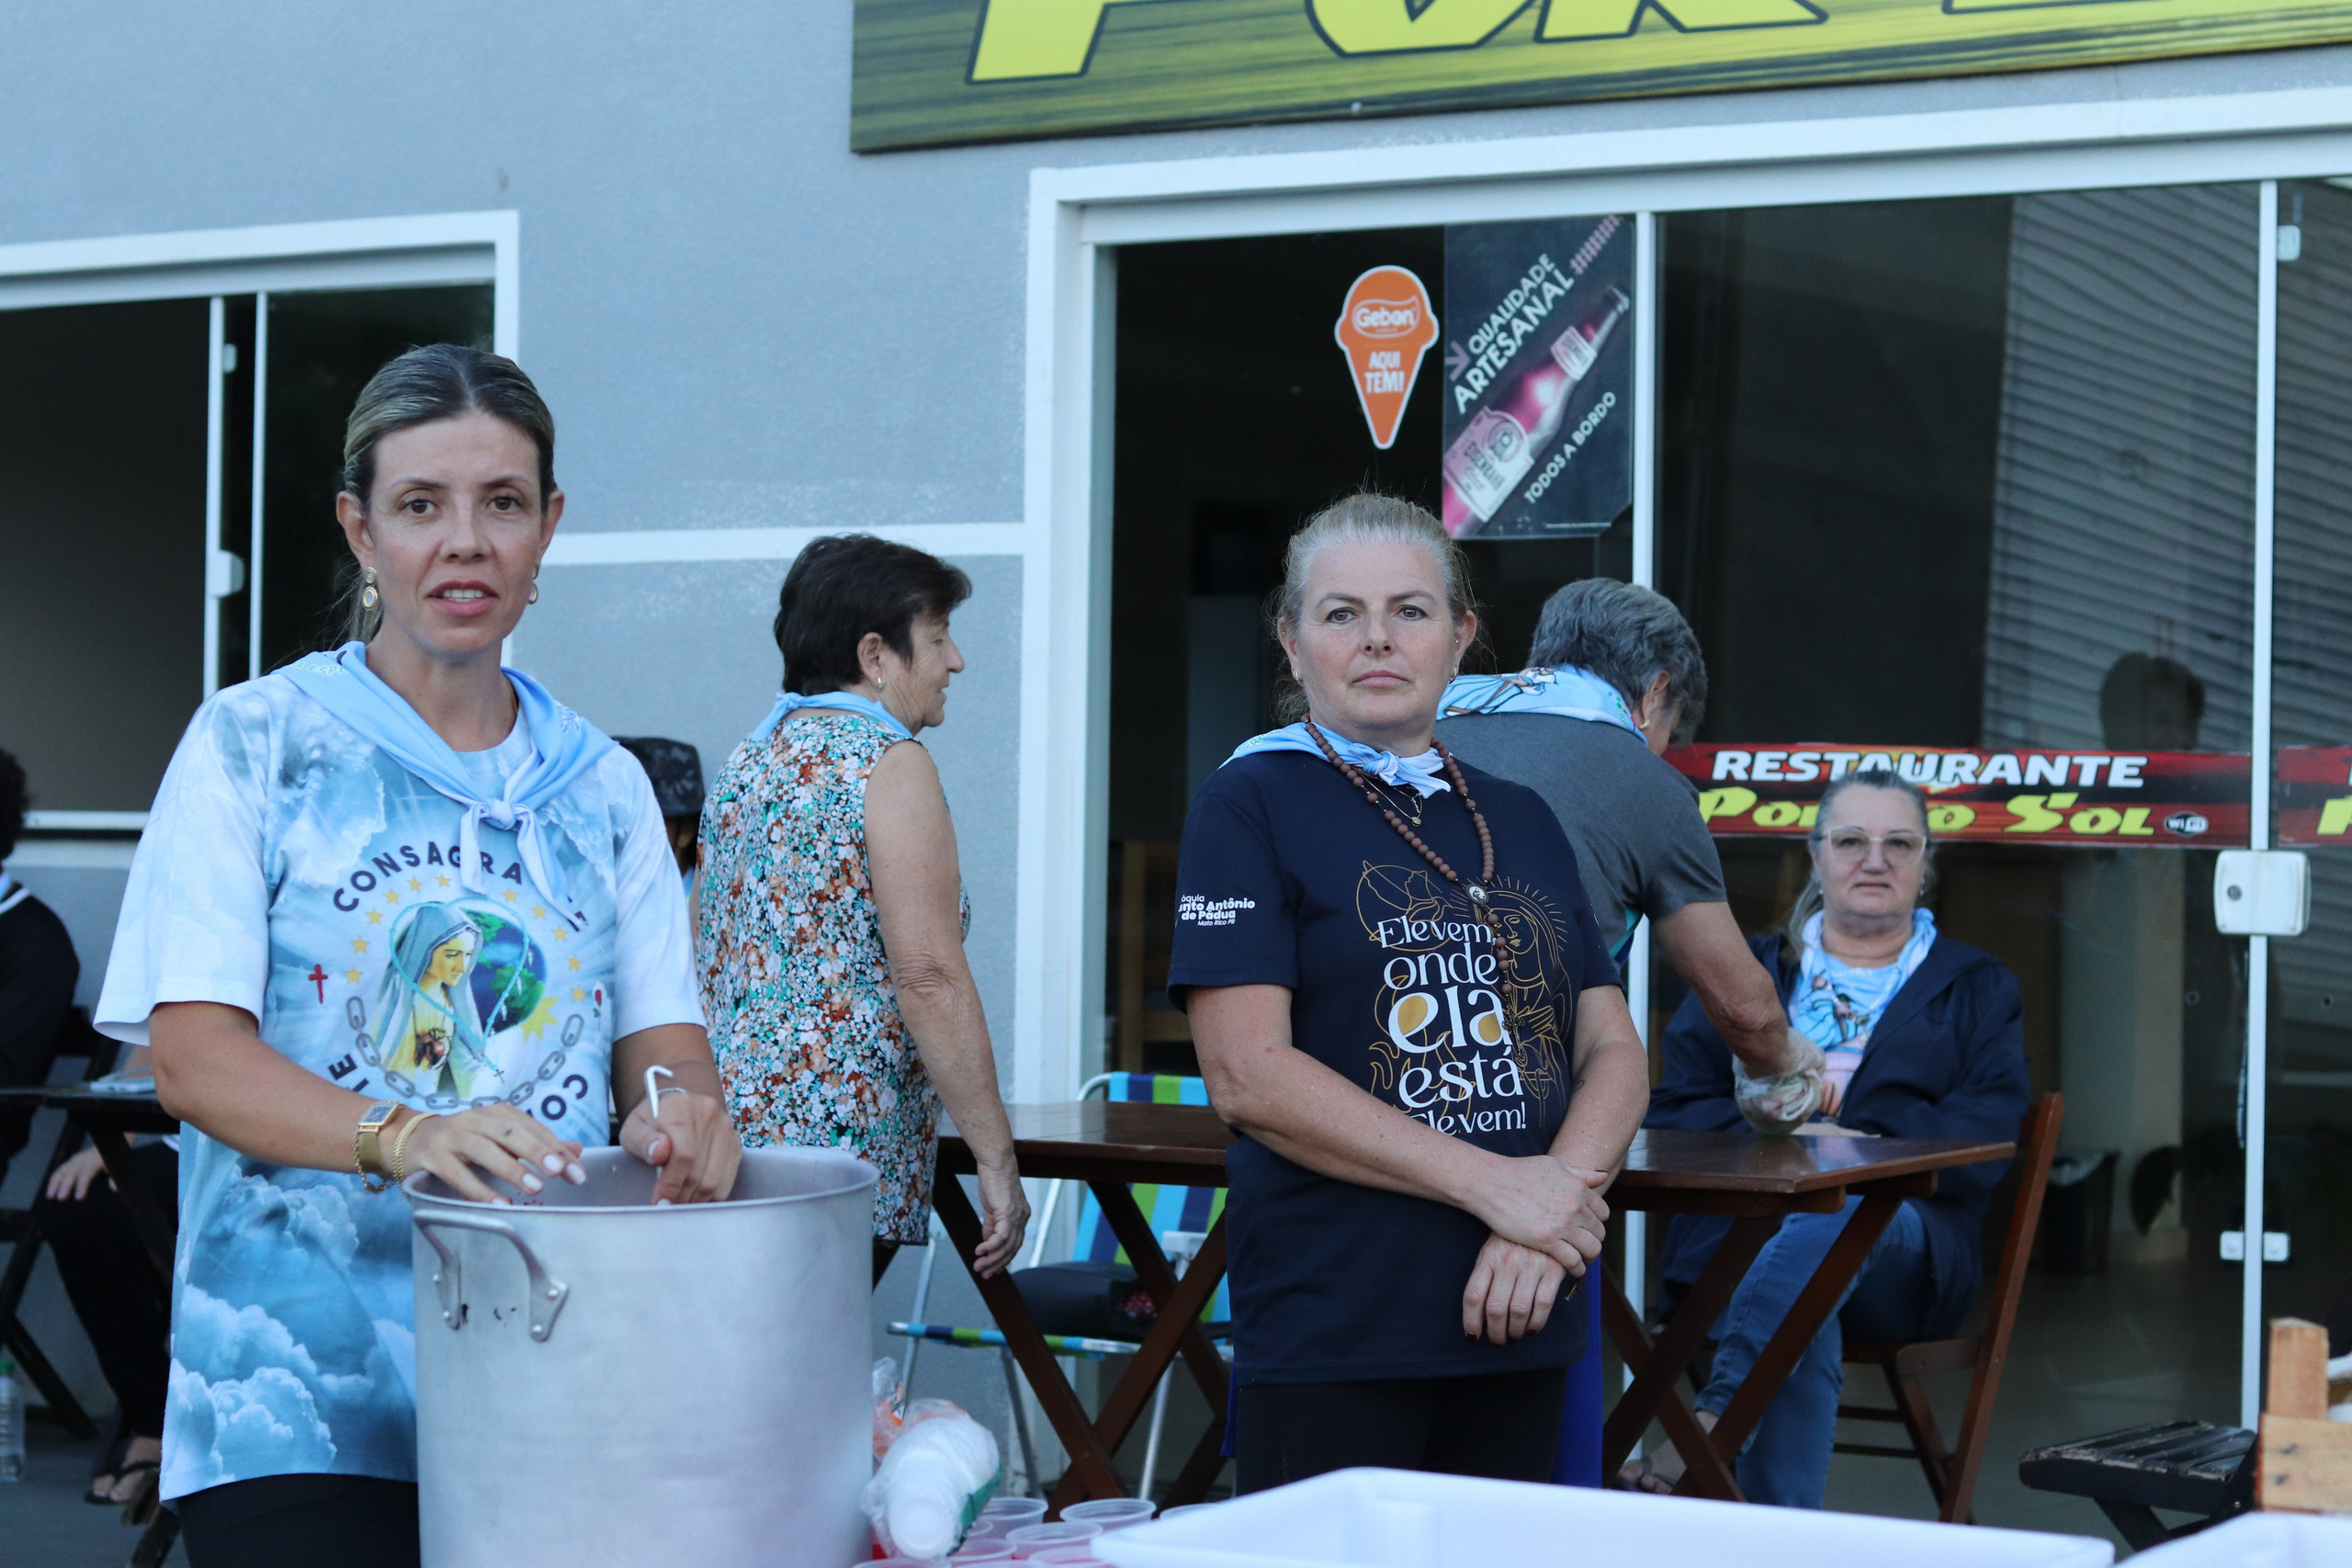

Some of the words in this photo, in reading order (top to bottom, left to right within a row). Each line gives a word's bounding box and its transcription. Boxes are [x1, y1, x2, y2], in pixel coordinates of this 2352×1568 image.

[1468, 254, 1555, 355] QUALIDADE
[1369, 351, 1401, 370] AQUI
[1454, 269, 1575, 415] ARTESANAL
[1364, 371, 1406, 394] TEM!
[1524, 454, 1566, 504] TODOS
[1563, 443, 1577, 459] A
[1571, 391, 1616, 446] BORDO
[1712, 750, 2148, 787] RESTAURANTE
[1181, 894, 1204, 904] óquia
[1181, 911, 1196, 920] de
[1198, 908, 1236, 919] Pádua
[1206, 897, 1255, 910] Antônio
[1384, 942, 1499, 990] onde
[1388, 986, 1513, 1054] ela
[1398, 1046, 1523, 1109] está
